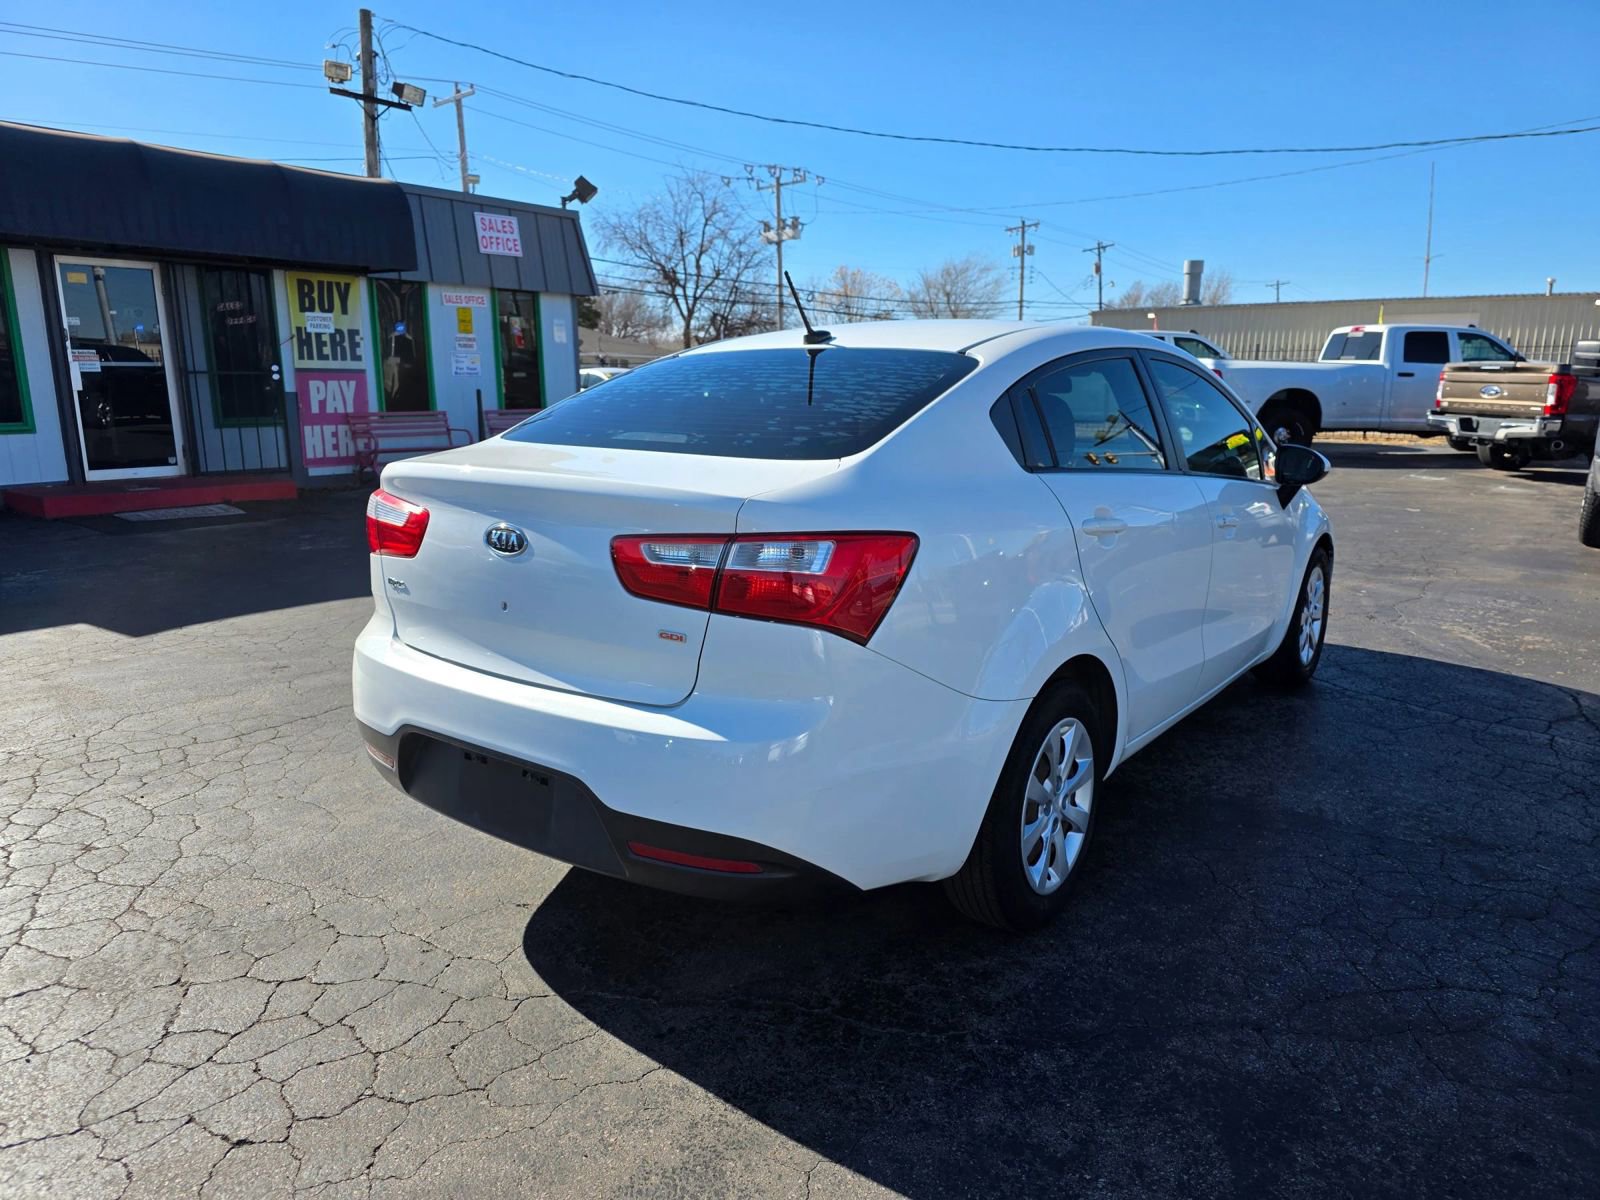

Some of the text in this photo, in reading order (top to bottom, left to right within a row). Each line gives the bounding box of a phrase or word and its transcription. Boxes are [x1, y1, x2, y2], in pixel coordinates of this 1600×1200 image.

[480, 217, 515, 235] SALES
[481, 235, 520, 253] OFFICE
[296, 278, 351, 315] BUY
[444, 293, 486, 306] SALES OFFICE
[309, 322, 332, 330] PARKING
[296, 326, 362, 362] HERE
[308, 380, 357, 414] PAY
[490, 529, 519, 551] KIA
[658, 631, 684, 642] GDI
